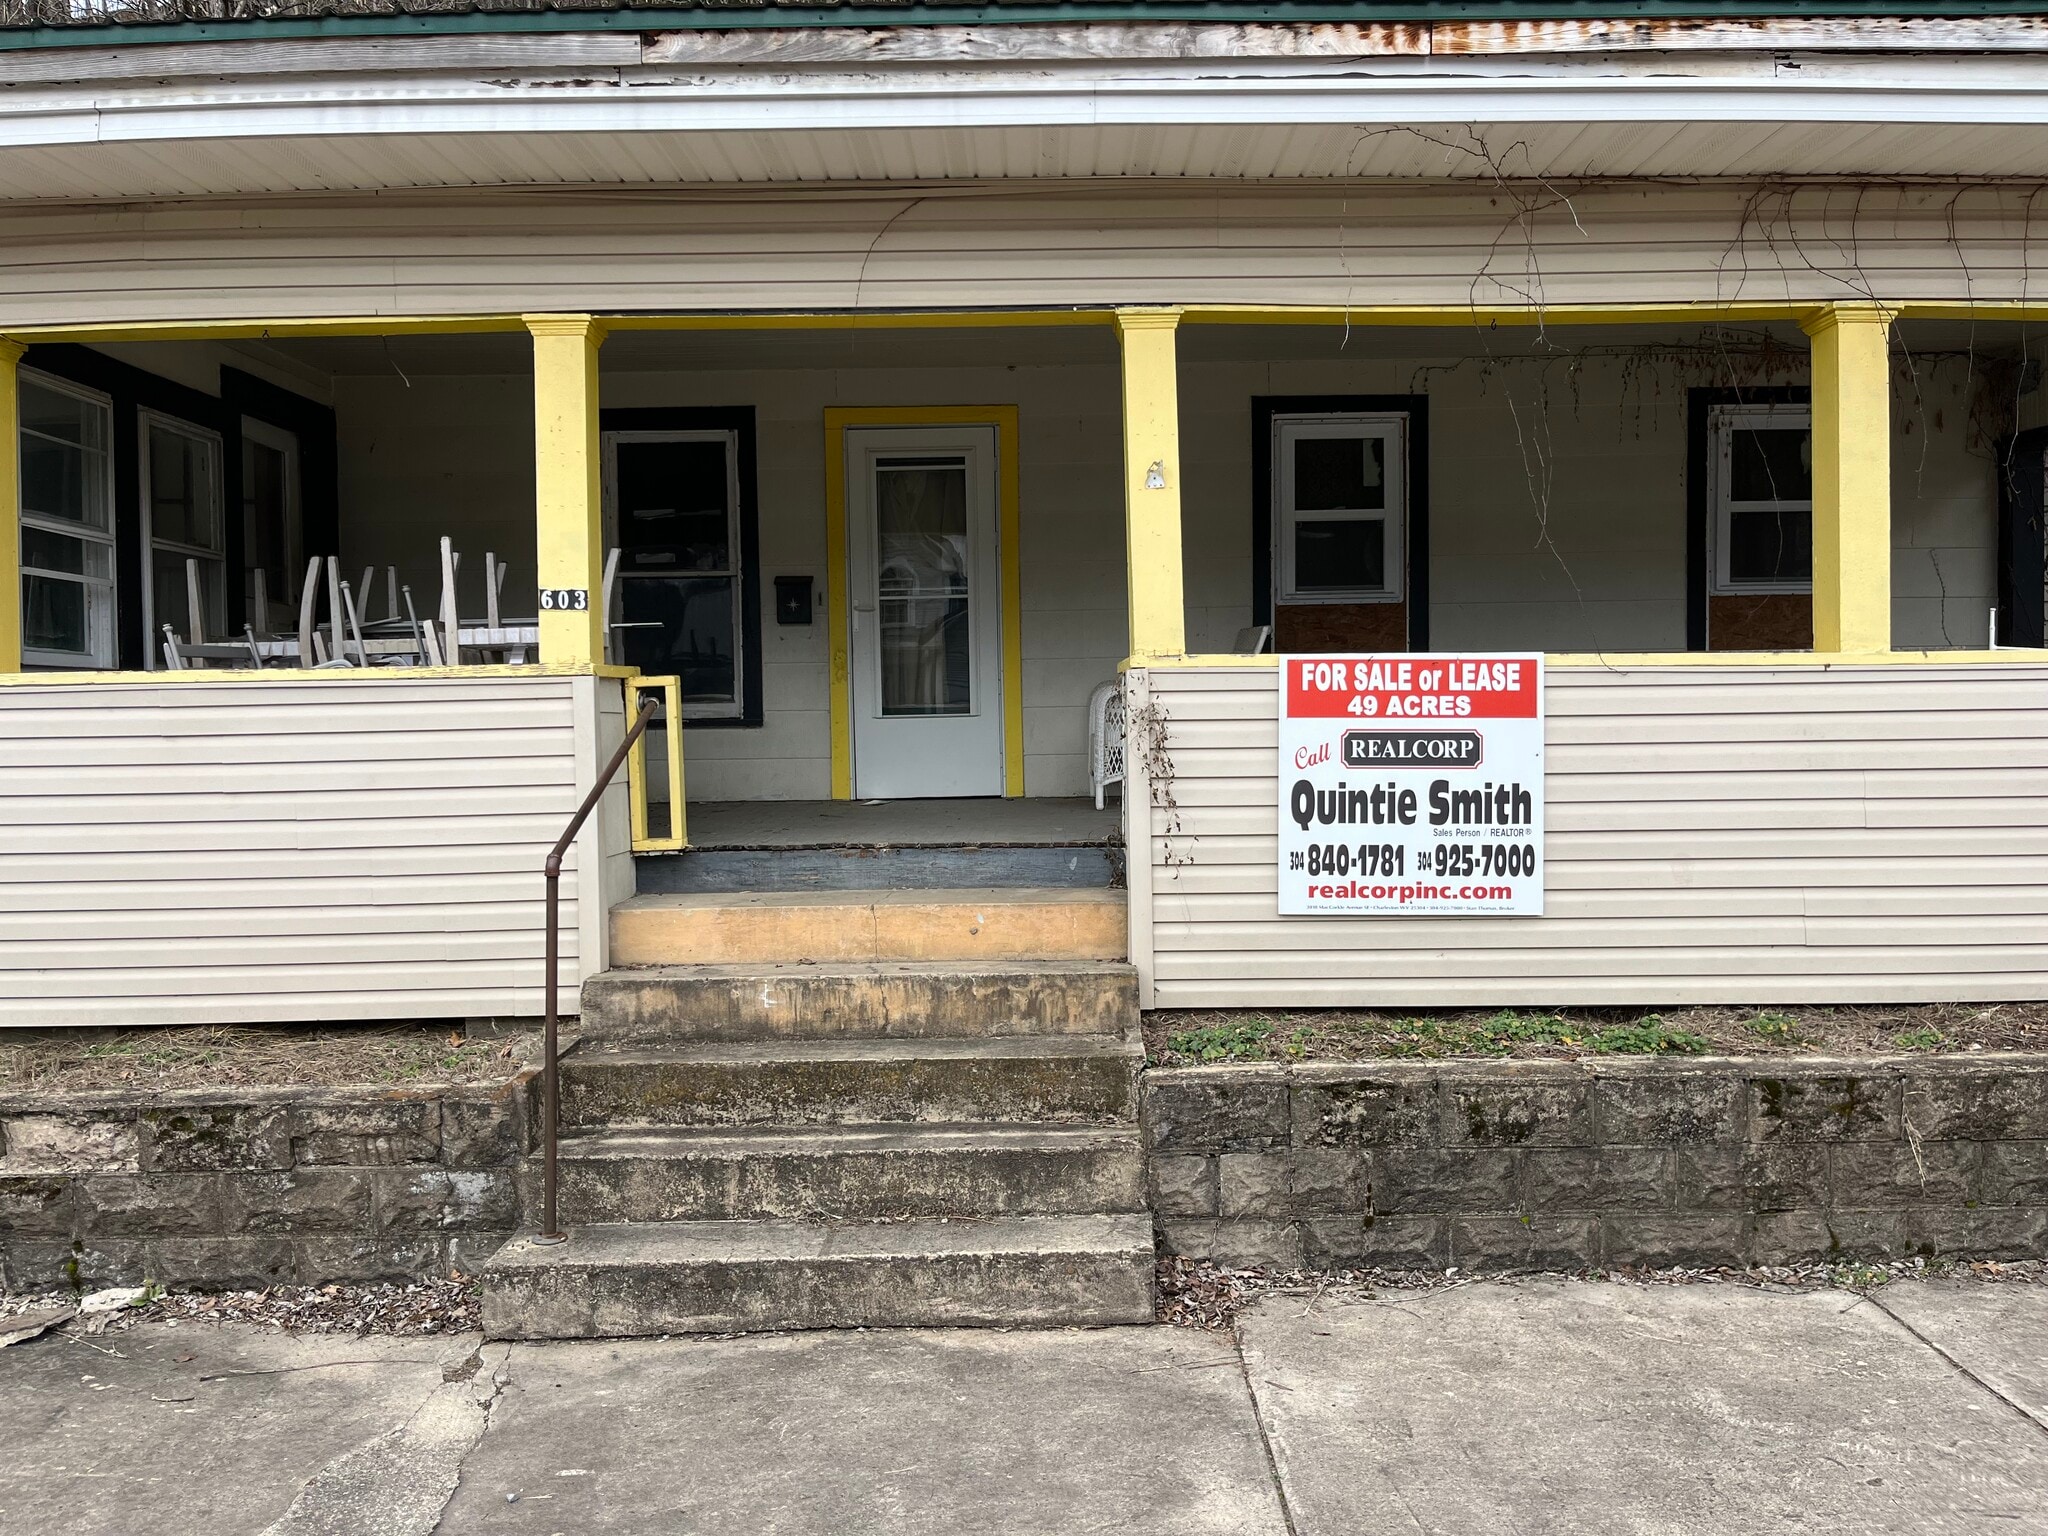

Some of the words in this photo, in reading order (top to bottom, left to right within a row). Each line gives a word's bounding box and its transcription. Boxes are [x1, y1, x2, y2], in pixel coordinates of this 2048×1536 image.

[540, 590, 586, 609] 603
[1301, 662, 1347, 691] FOR
[1354, 662, 1412, 691] SALE
[1418, 668, 1443, 691] or
[1448, 662, 1521, 692] LEASE
[1347, 695, 1378, 716] 49
[1386, 695, 1472, 716] ACRES
[1294, 742, 1331, 769] Call
[1350, 739, 1474, 759] REALCORP
[1291, 779, 1417, 831] Quintie
[1428, 779, 1532, 826] Smith
[1433, 828, 1453, 837] Sales
[1455, 828, 1481, 837] Person
[1290, 851, 1305, 872] 304
[1307, 844, 1405, 877] 840-1781
[1417, 851, 1432, 872] 304
[1435, 843, 1535, 877] 925-7000
[1308, 881, 1513, 904] realcorpinc.com
